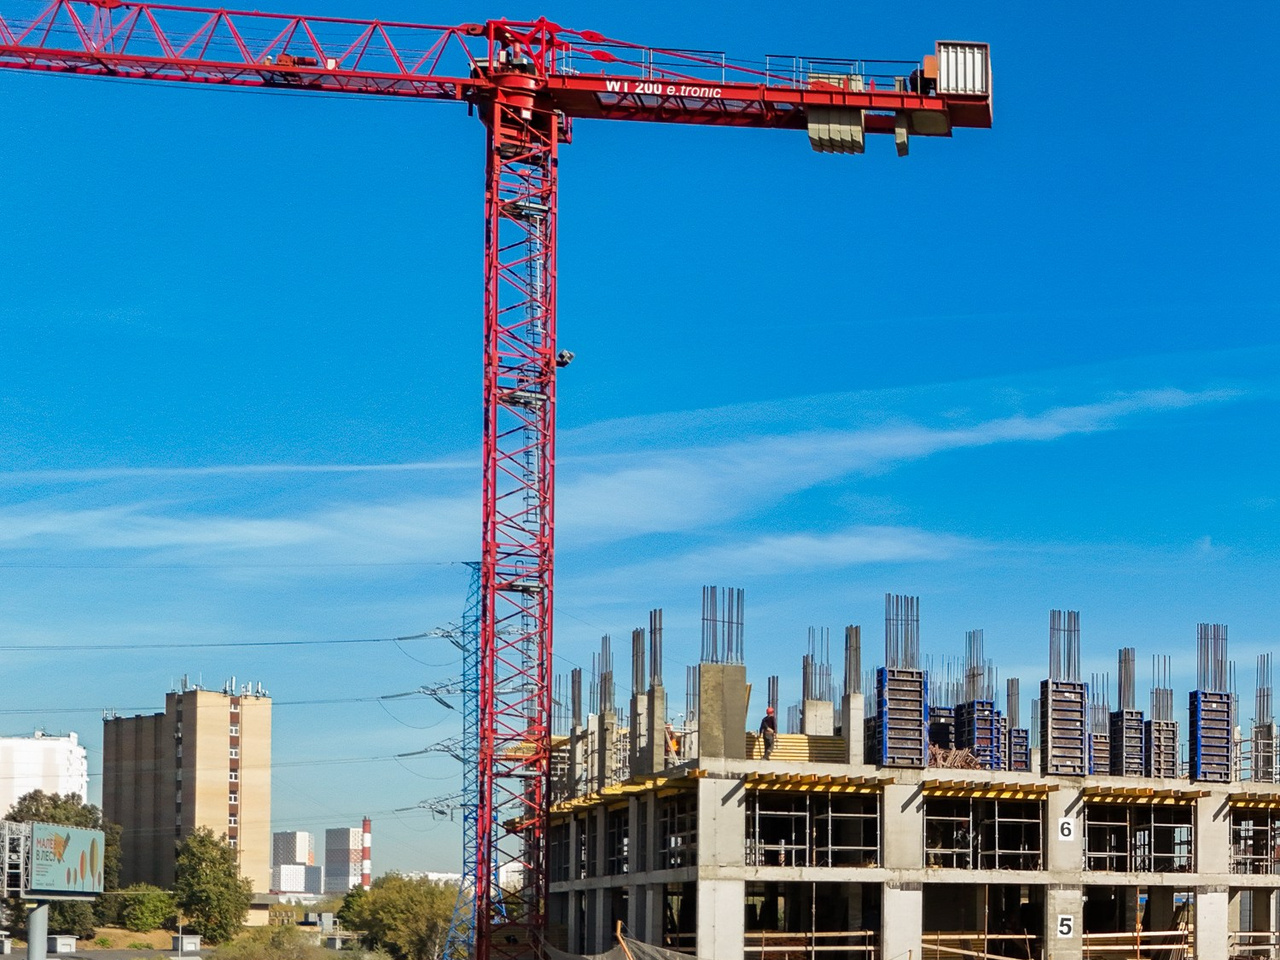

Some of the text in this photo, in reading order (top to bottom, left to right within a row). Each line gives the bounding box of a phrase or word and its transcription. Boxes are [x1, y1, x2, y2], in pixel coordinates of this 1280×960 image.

[634, 81, 662, 95] 200
[667, 84, 722, 98] e.tronic
[1060, 821, 1072, 837] 6
[1058, 917, 1072, 936] 5
